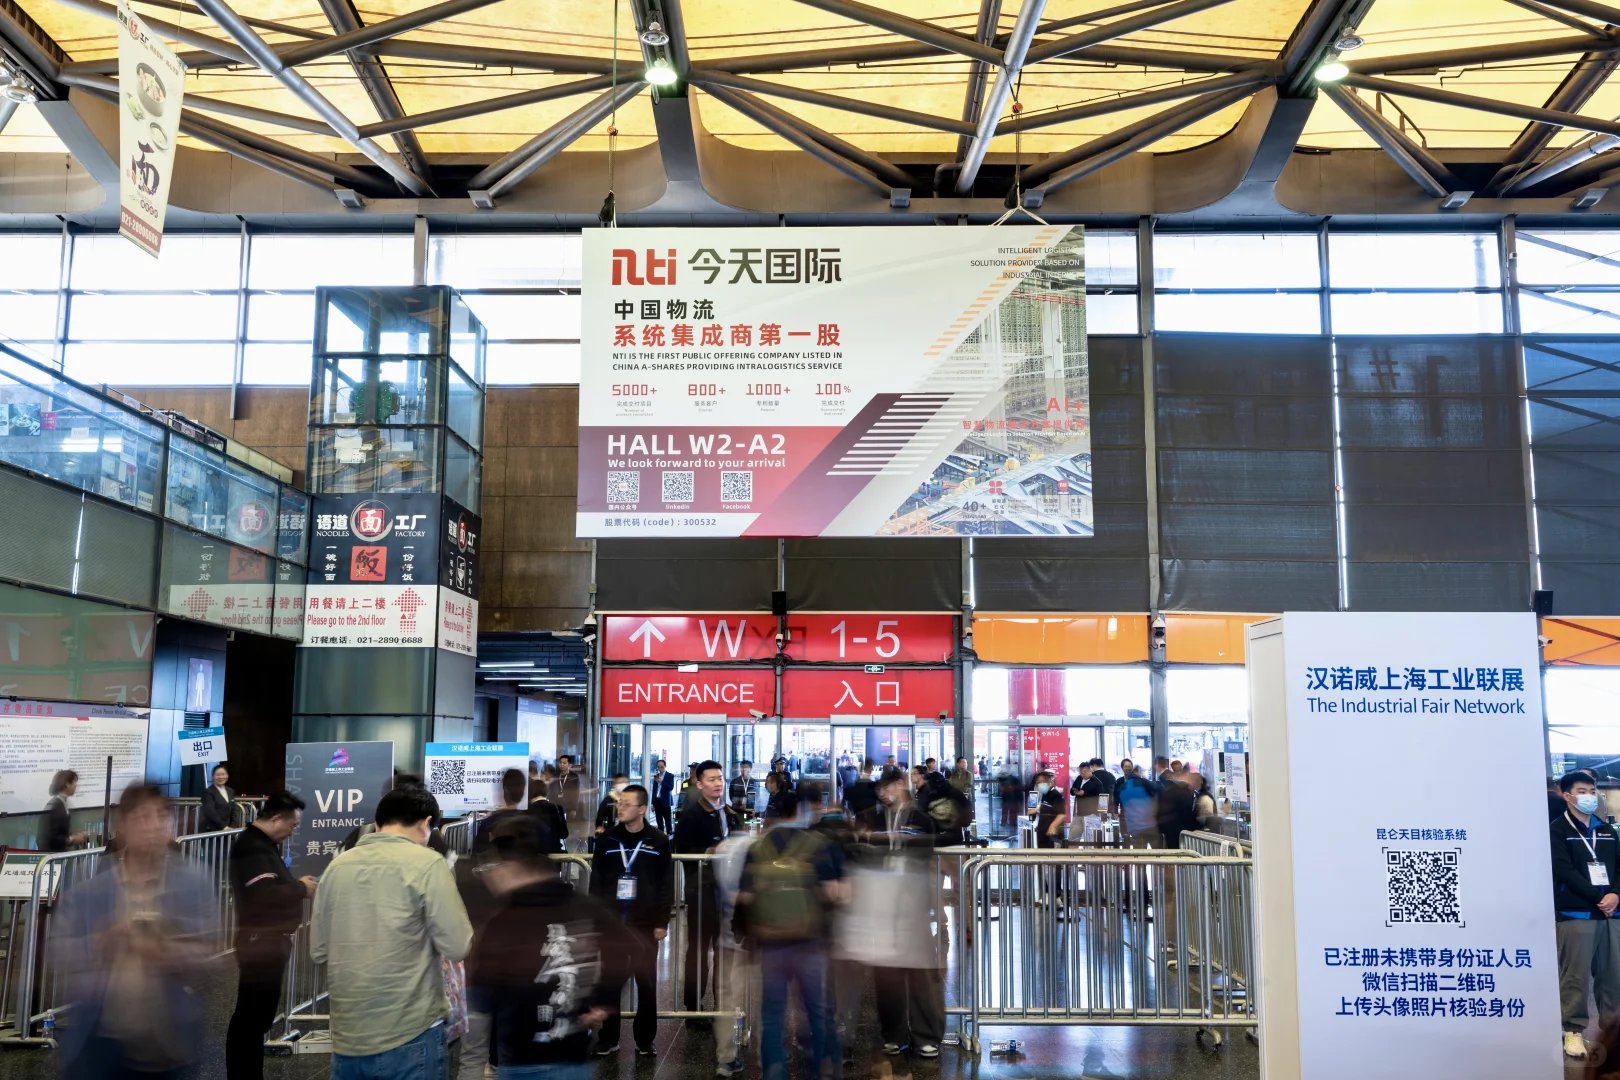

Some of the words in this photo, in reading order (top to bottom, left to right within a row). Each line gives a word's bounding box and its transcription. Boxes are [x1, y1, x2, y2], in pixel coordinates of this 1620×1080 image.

[688, 248, 842, 284] 今天国际
[614, 299, 714, 320] 中国物流
[613, 323, 840, 346] 系统集成商第一股
[612, 384, 658, 396] 5000+
[688, 384, 726, 396] 800+
[746, 384, 790, 395] 1000+
[816, 384, 852, 395] 100%
[1046, 398, 1084, 412] AI+
[608, 435, 682, 455] HALL
[689, 434, 786, 455] W2-A2
[608, 459, 626, 468] We
[628, 458, 652, 467] look
[656, 458, 701, 467] forward
[718, 460, 744, 469] your
[747, 458, 786, 467] arrival
[317, 514, 348, 530] 语道
[361, 510, 381, 533] 面
[395, 515, 426, 530] 工厂
[605, 518, 640, 527] 股票代码
[309, 598, 386, 609] 用餐请上二楼
[307, 615, 327, 625] Please
[328, 617, 336, 627] go
[339, 617, 344, 625] to
[347, 615, 356, 625] the
[358, 615, 370, 625] 2nd
[371, 615, 386, 625] floor
[699, 620, 746, 658] W
[830, 620, 900, 658] 1-5
[1306, 667, 1524, 692] 汉诺威上海工业联展
[618, 683, 754, 703] ENTRANCE
[834, 680, 900, 708] 入口
[1307, 698, 1337, 713] The
[1342, 698, 1417, 713] Industrial
[1422, 698, 1450, 713] Fair
[1454, 699, 1525, 714] Network
[193, 741, 212, 751] 出口
[315, 789, 363, 813] VIP
[1376, 828, 1467, 841] 昆仑天目核验系统
[306, 841, 343, 856] 贵宾
[1324, 947, 1532, 968] 已注册未携带身份证人员
[1362, 972, 1496, 992] 微信扫描二维码
[1335, 996, 1526, 1018] 上传头像照片核验身份
